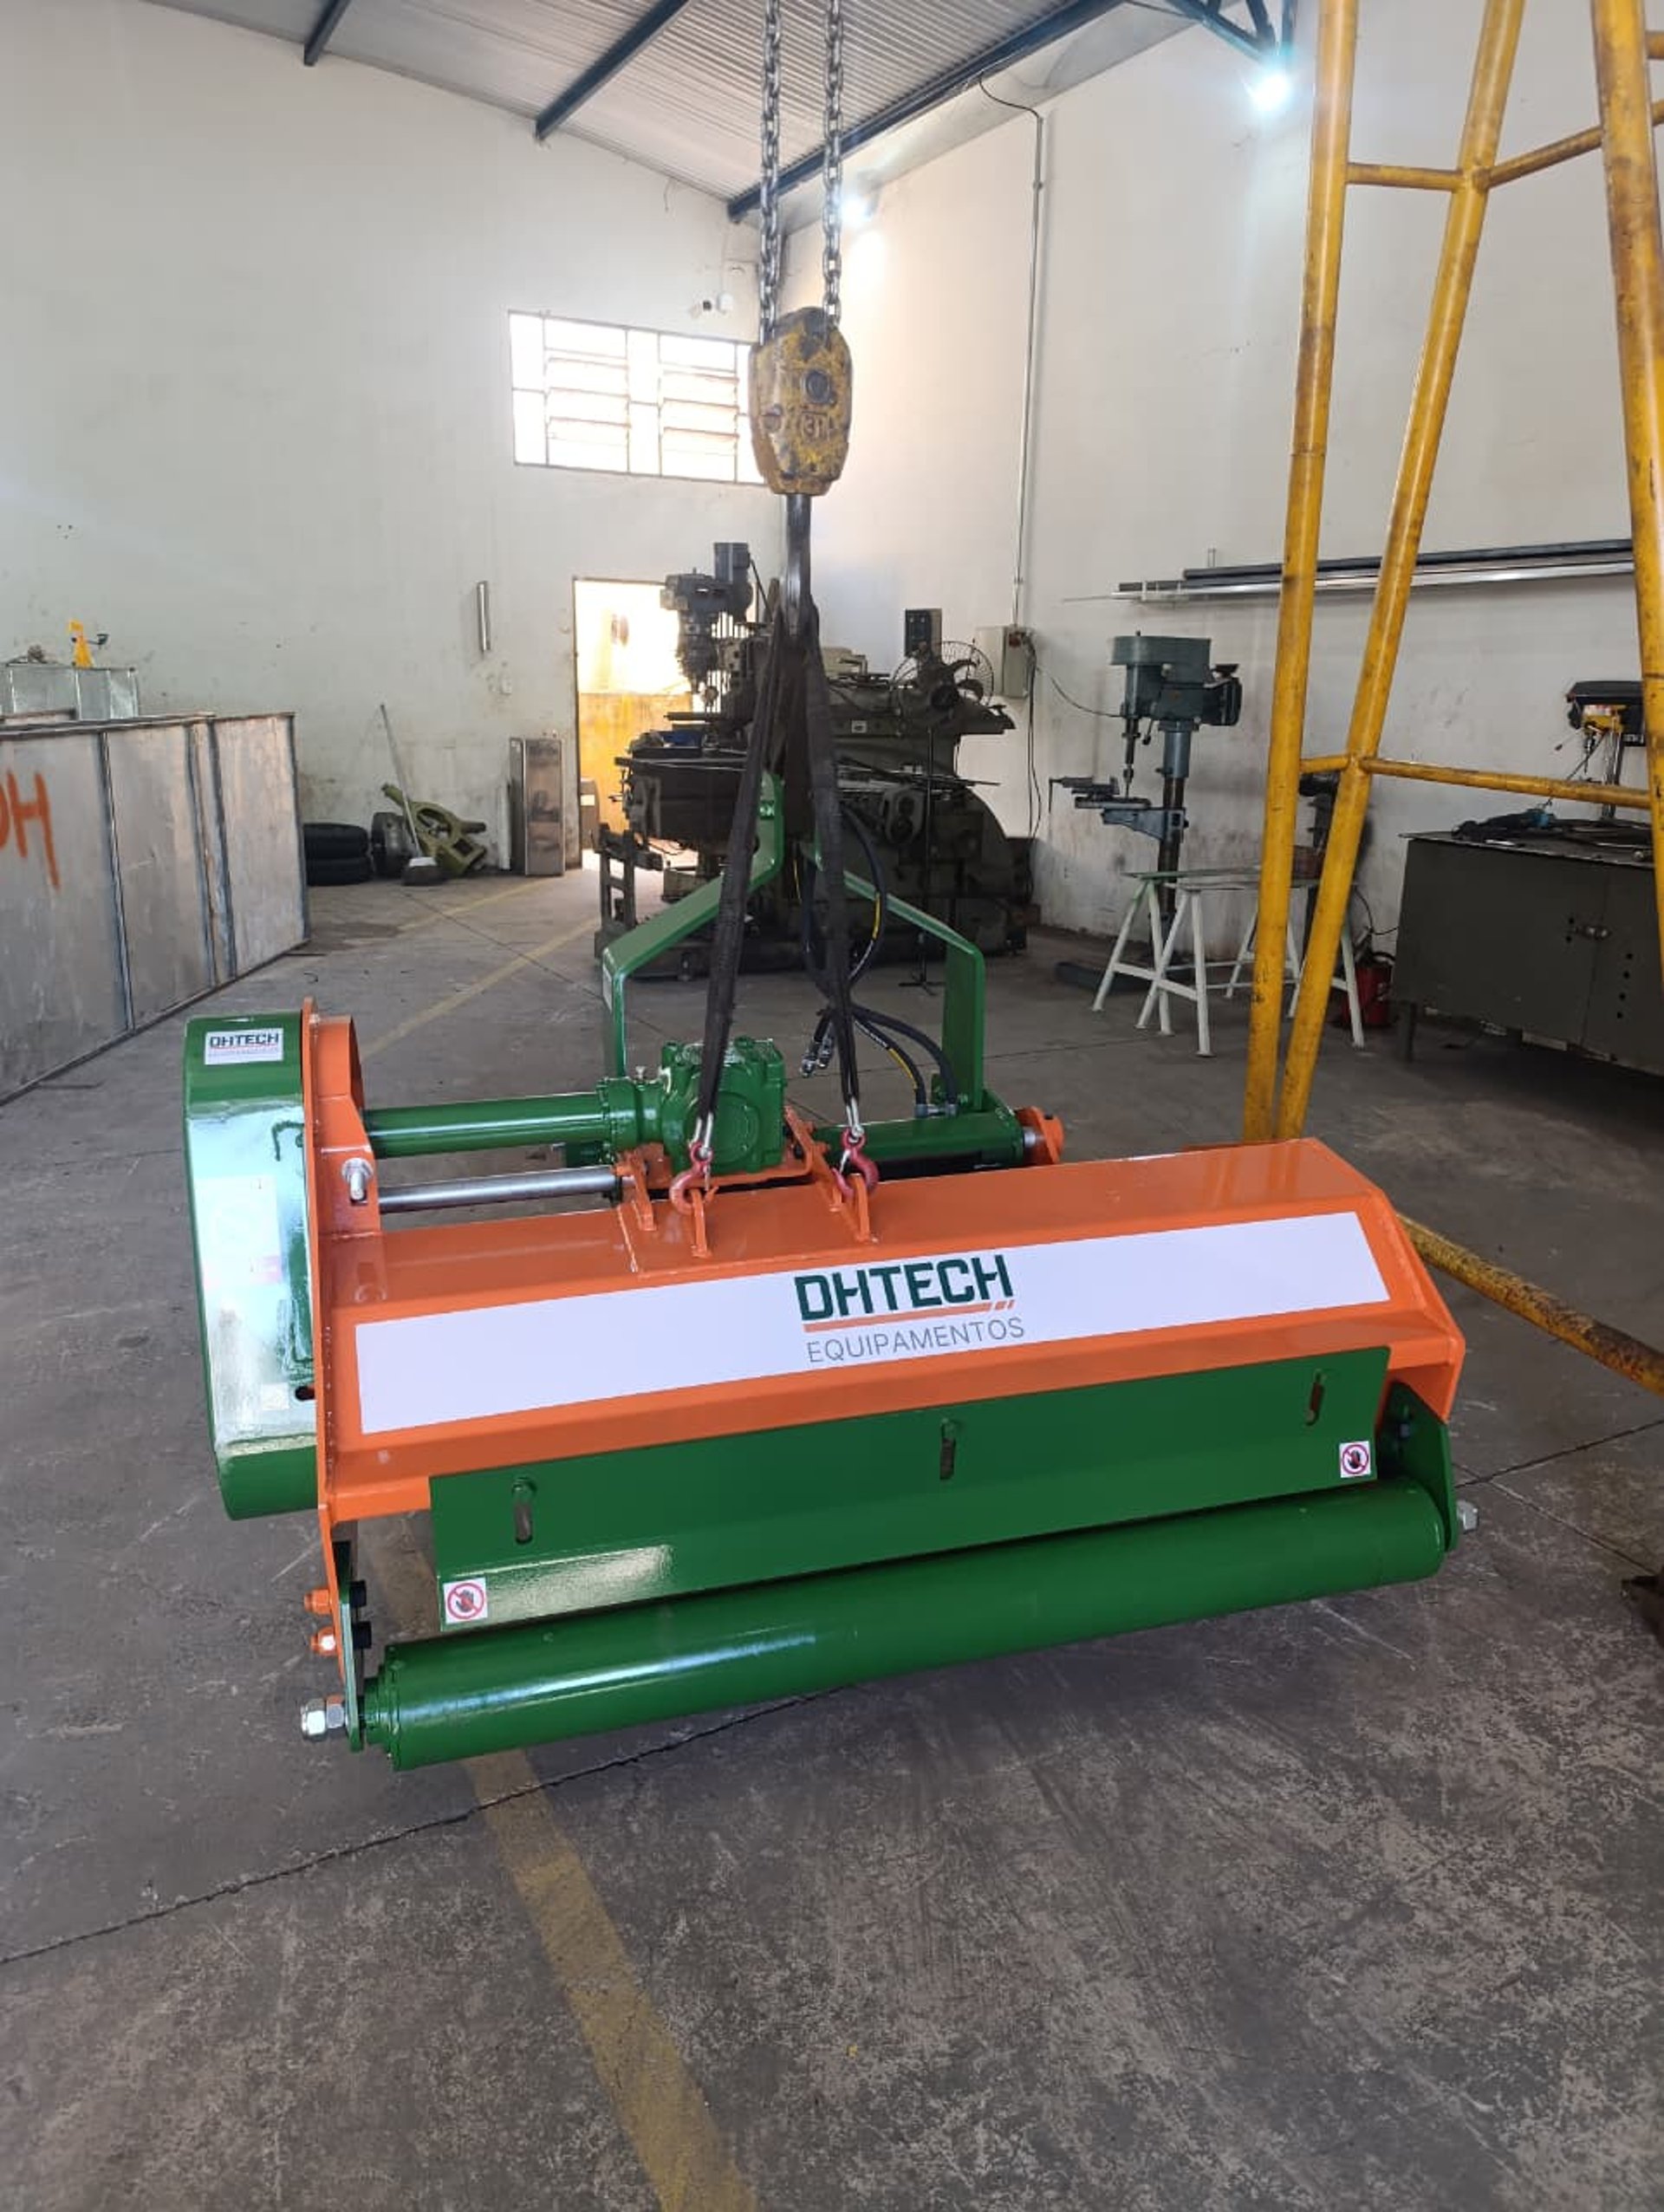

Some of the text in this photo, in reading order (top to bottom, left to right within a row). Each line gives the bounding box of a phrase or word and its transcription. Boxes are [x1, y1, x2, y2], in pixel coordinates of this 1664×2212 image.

[210, 1032, 279, 1048] DHTECH
[794, 1254, 1014, 1321] DHTECH
[806, 1317, 1024, 1363] EQUIPAMENTOS
